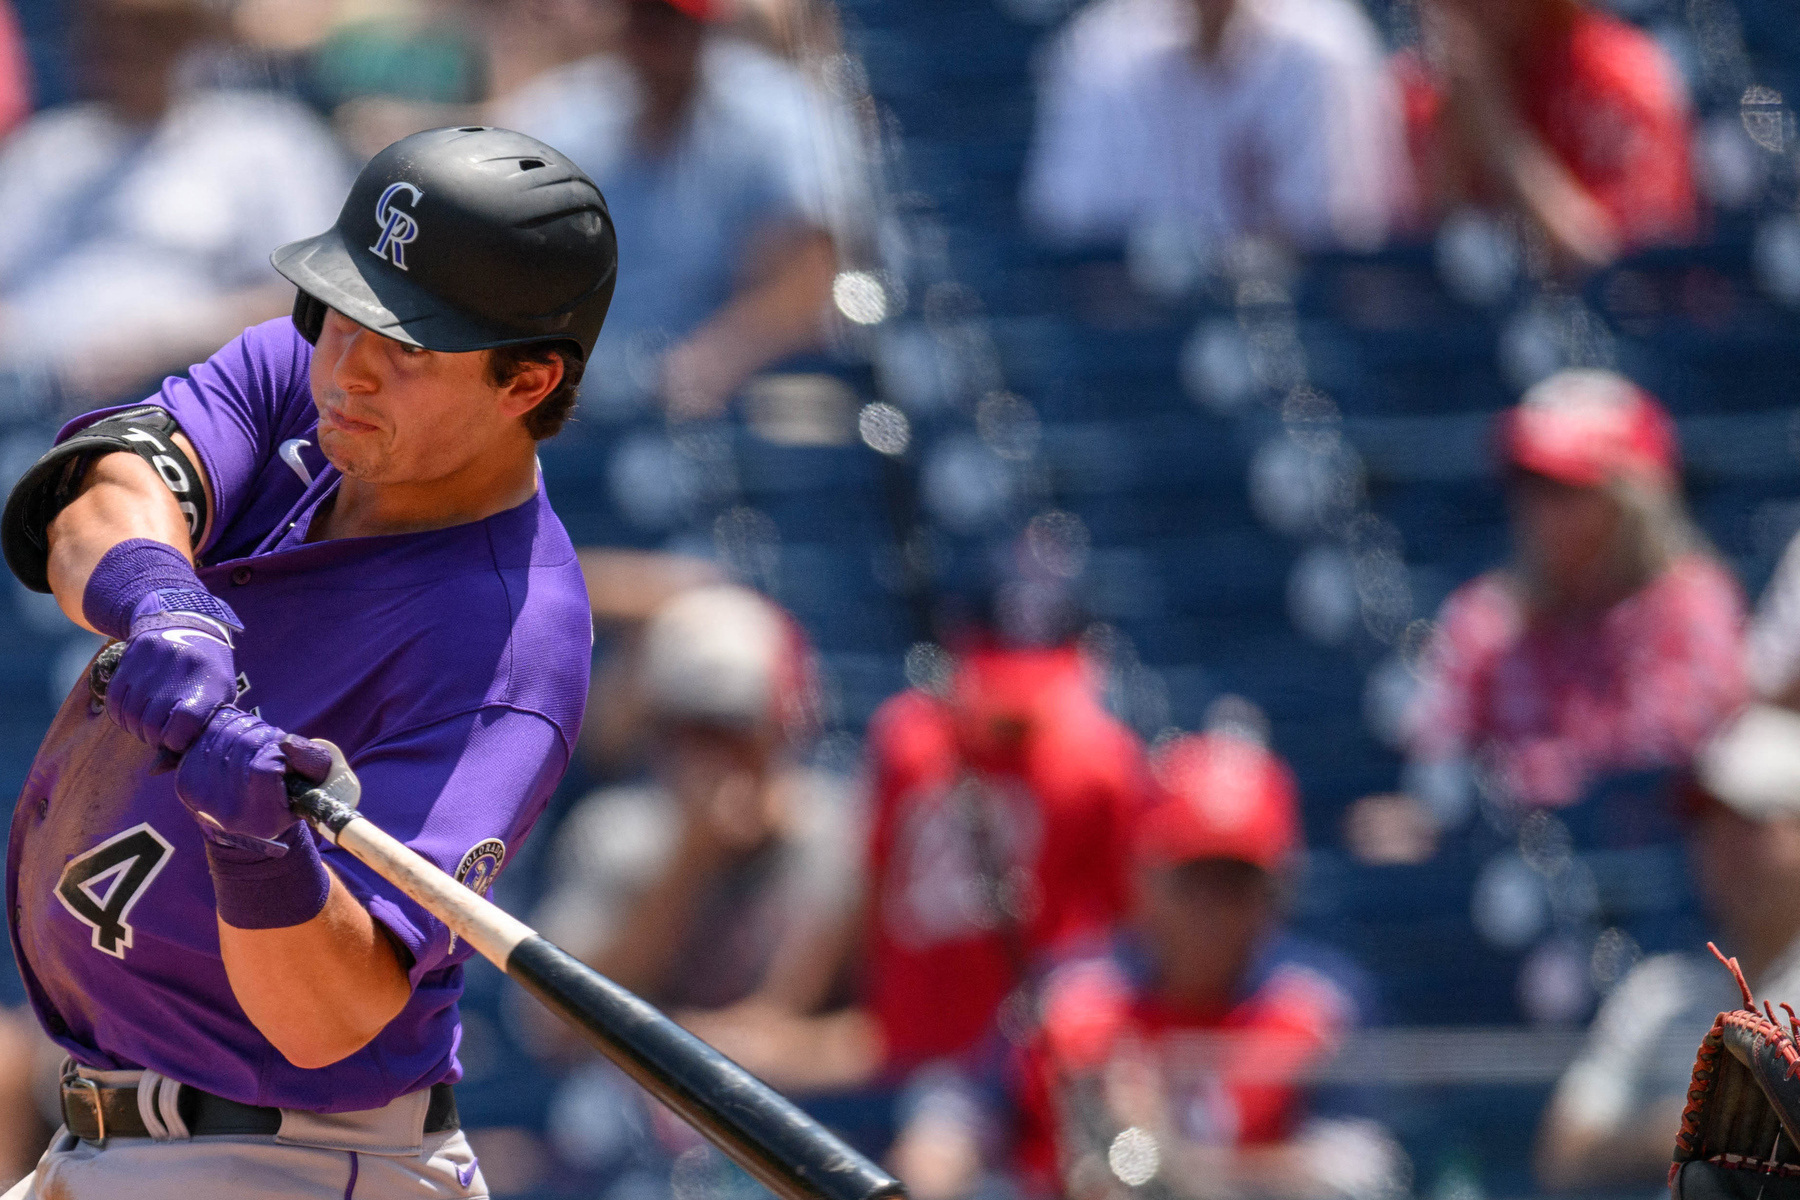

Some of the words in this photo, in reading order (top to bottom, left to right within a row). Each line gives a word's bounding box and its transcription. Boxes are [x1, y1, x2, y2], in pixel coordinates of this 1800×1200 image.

[368, 182, 423, 271] CR
[53, 821, 176, 960] 4
[460, 842, 504, 875] COLORADO
